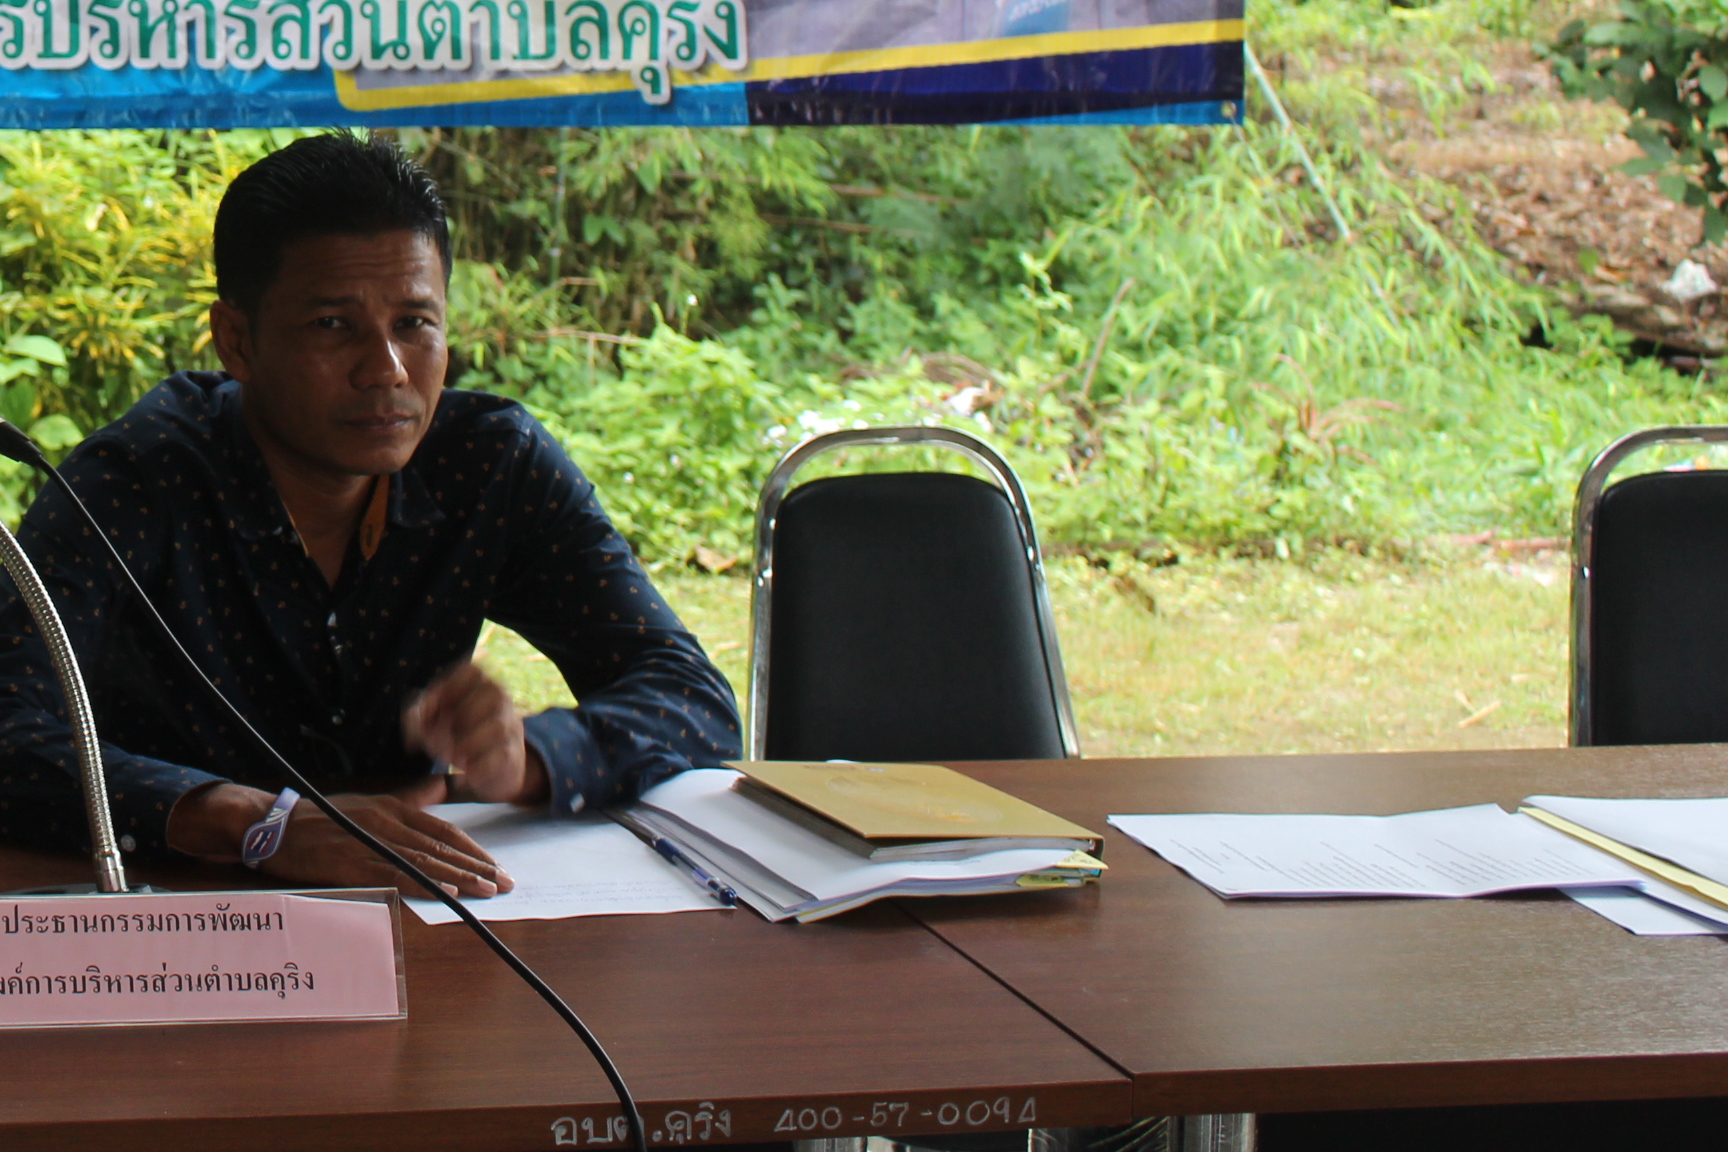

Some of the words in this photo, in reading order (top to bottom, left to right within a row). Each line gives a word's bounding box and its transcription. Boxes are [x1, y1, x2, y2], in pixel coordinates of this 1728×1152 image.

[1, 902, 284, 935] ประธานกรรมการพัฒนา
